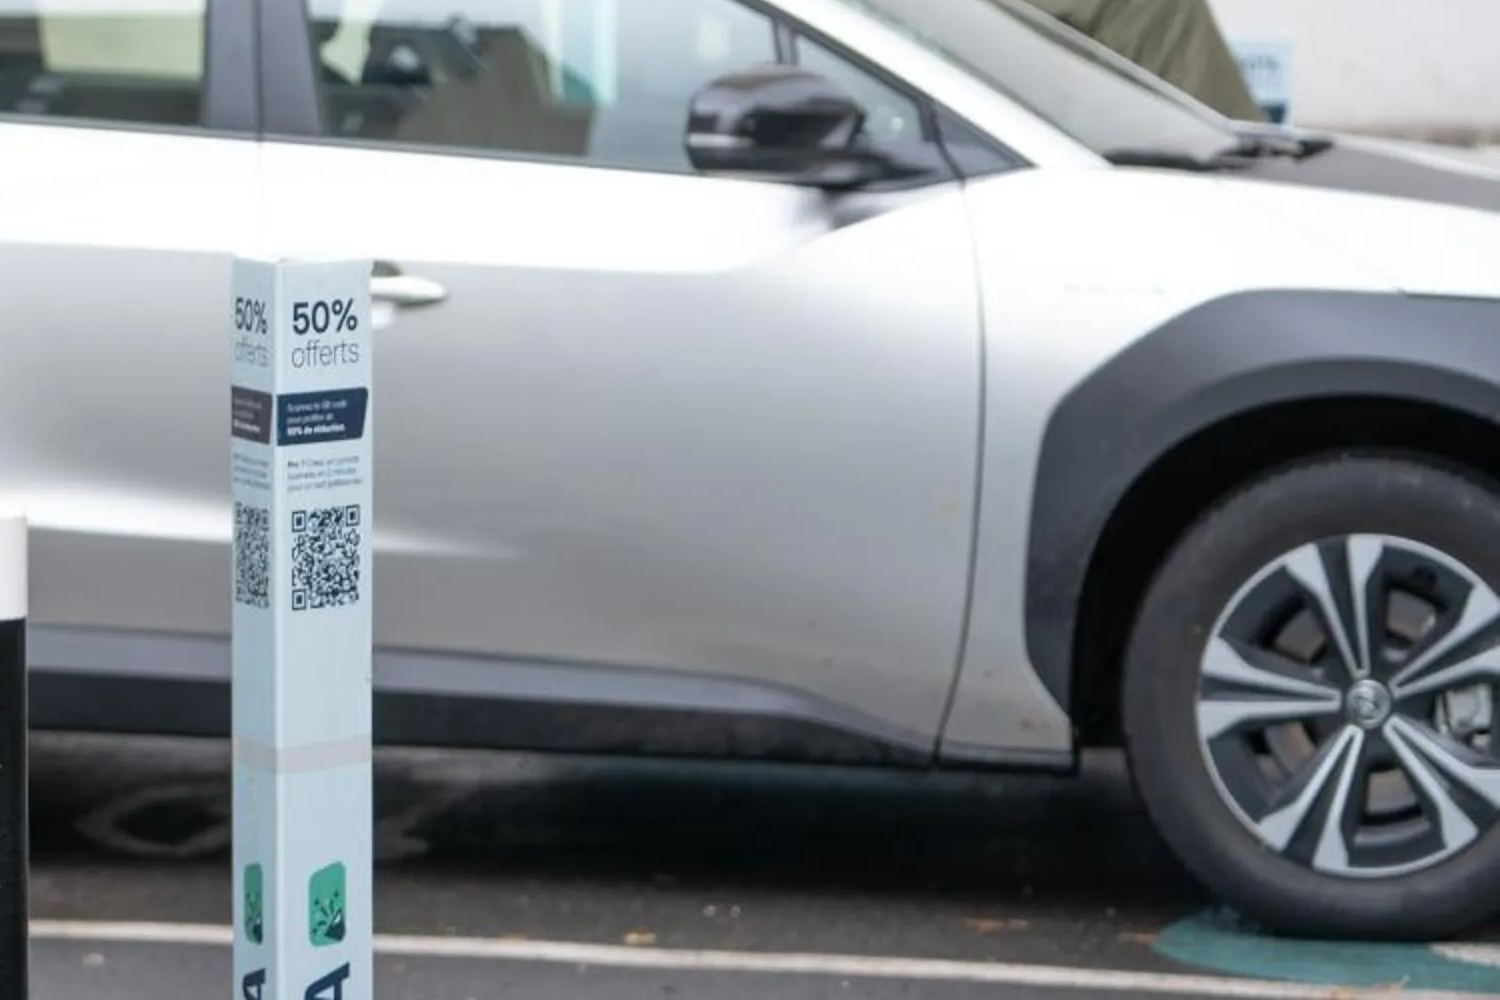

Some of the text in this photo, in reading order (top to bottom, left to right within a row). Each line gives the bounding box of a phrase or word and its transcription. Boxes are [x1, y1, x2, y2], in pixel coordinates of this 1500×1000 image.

[234, 297, 268, 335] 50%
[292, 298, 358, 335] 50%
[291, 339, 360, 369] offerts
